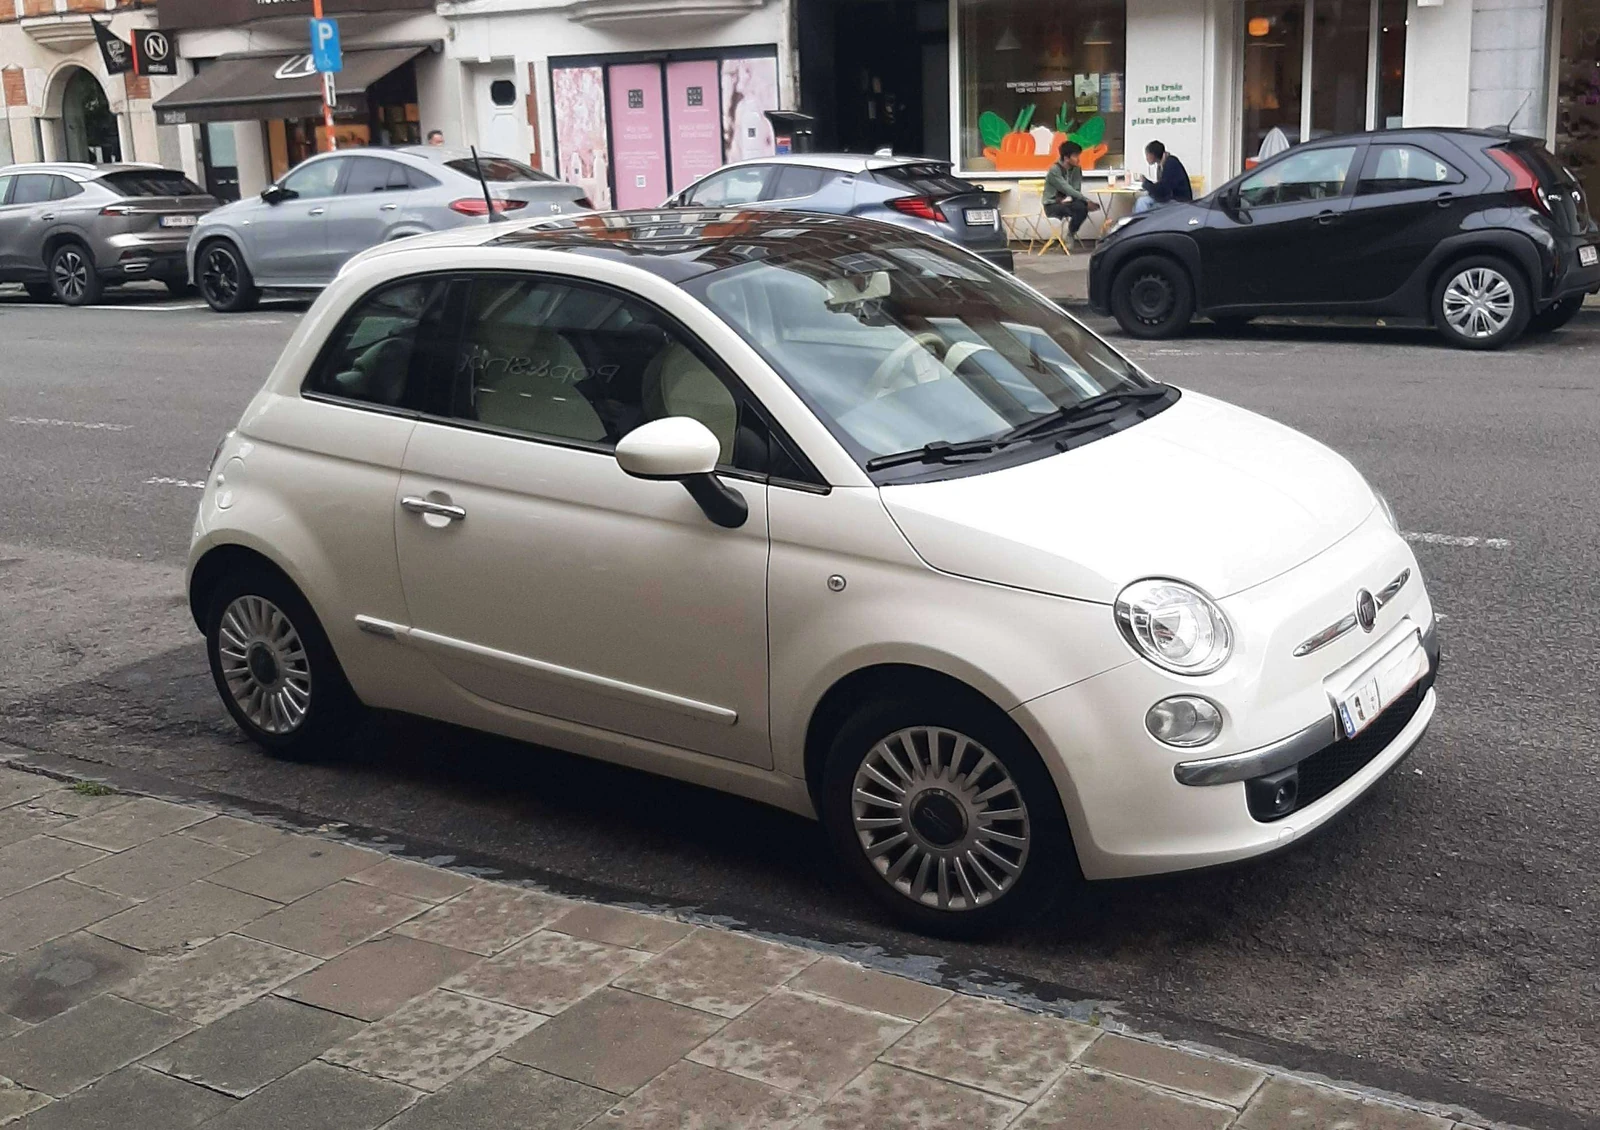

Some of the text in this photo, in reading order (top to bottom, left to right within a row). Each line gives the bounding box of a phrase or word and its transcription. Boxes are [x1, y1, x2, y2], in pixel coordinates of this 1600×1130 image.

[318, 22, 333, 50] P
[149, 38, 164, 56] N
[1161, 83, 1183, 91] frais
[1138, 94, 1190, 103] sandwiches
[1147, 105, 1180, 114] salades
[1131, 117, 1154, 126] plats
